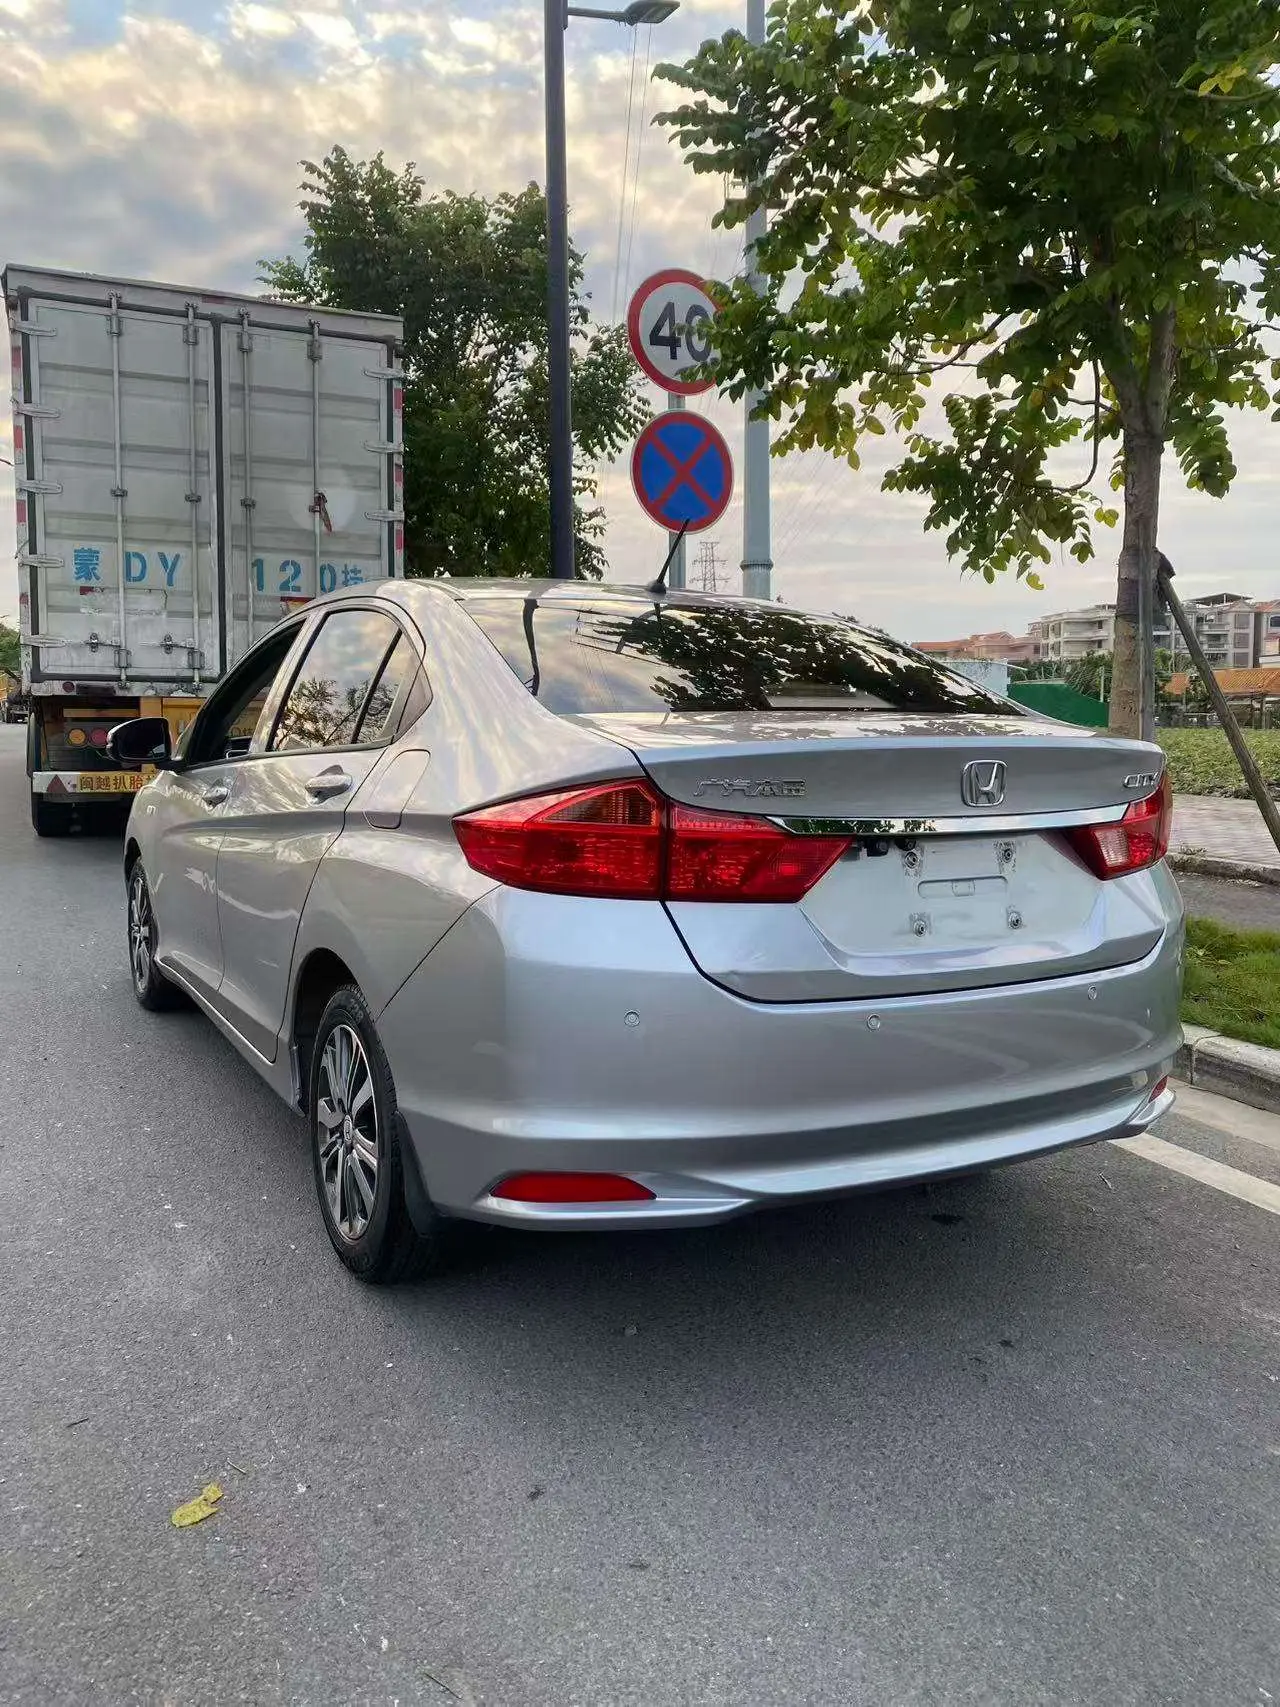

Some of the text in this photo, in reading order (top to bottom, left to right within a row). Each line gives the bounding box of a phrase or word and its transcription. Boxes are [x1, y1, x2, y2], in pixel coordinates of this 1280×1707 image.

[649, 301, 712, 363] 40
[73, 547, 101, 582] 蒙
[125, 550, 181, 587] DY
[80, 775, 153, 791] 闽越扒胎
